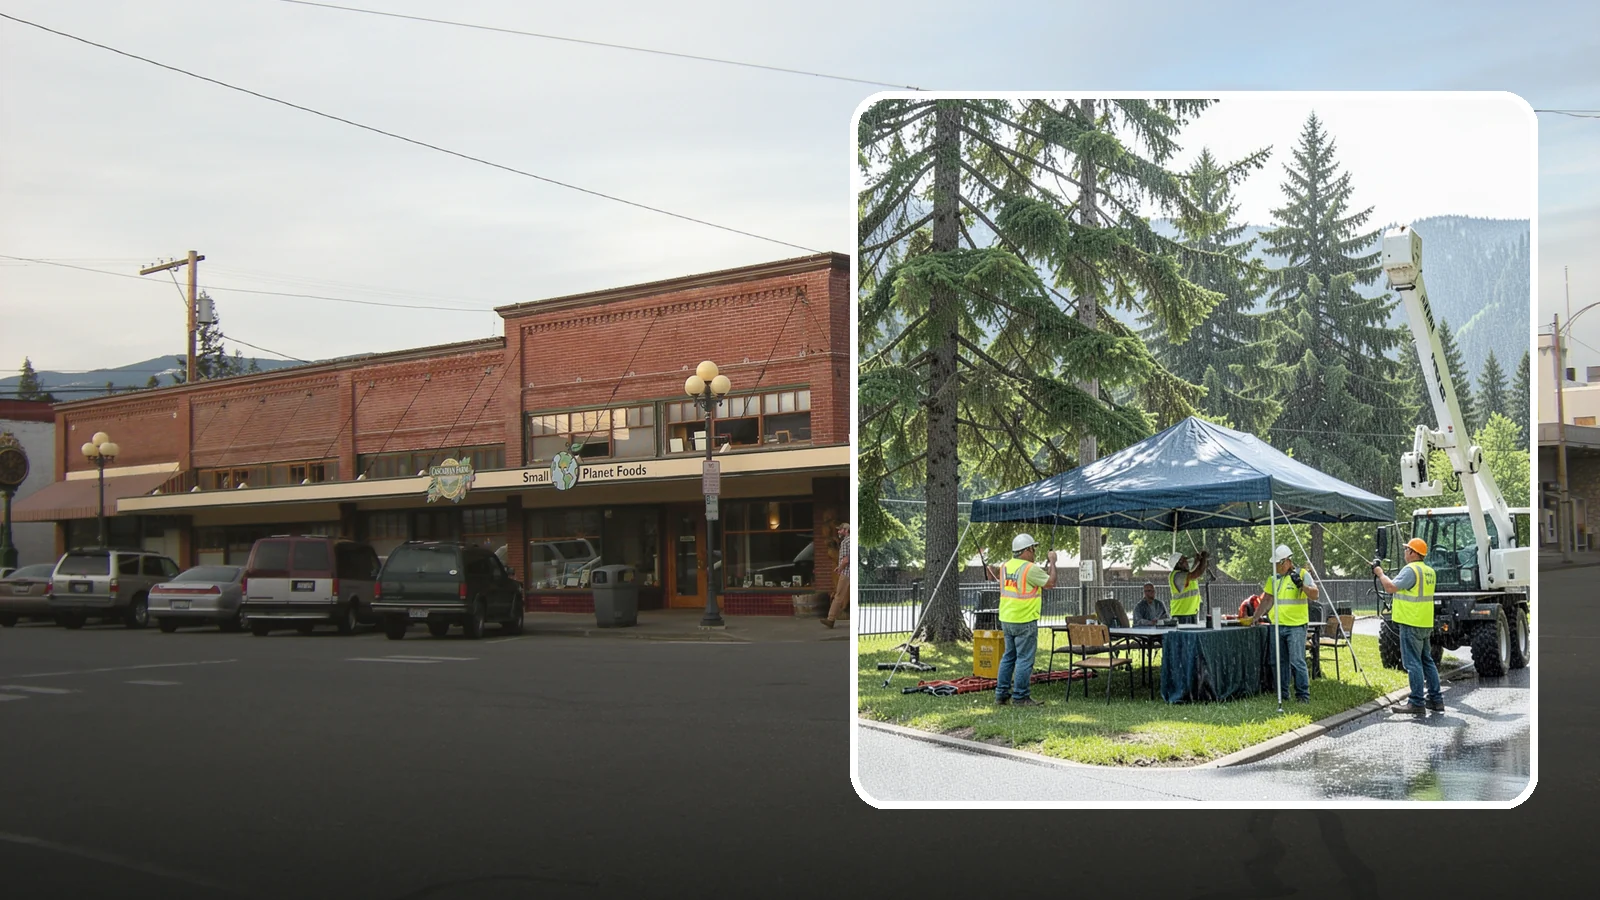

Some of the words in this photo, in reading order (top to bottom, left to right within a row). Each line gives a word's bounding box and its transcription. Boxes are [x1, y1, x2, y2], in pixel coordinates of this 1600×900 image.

[523, 470, 549, 483] Small
[583, 468, 614, 479] Planet
[617, 464, 647, 477] Foods
